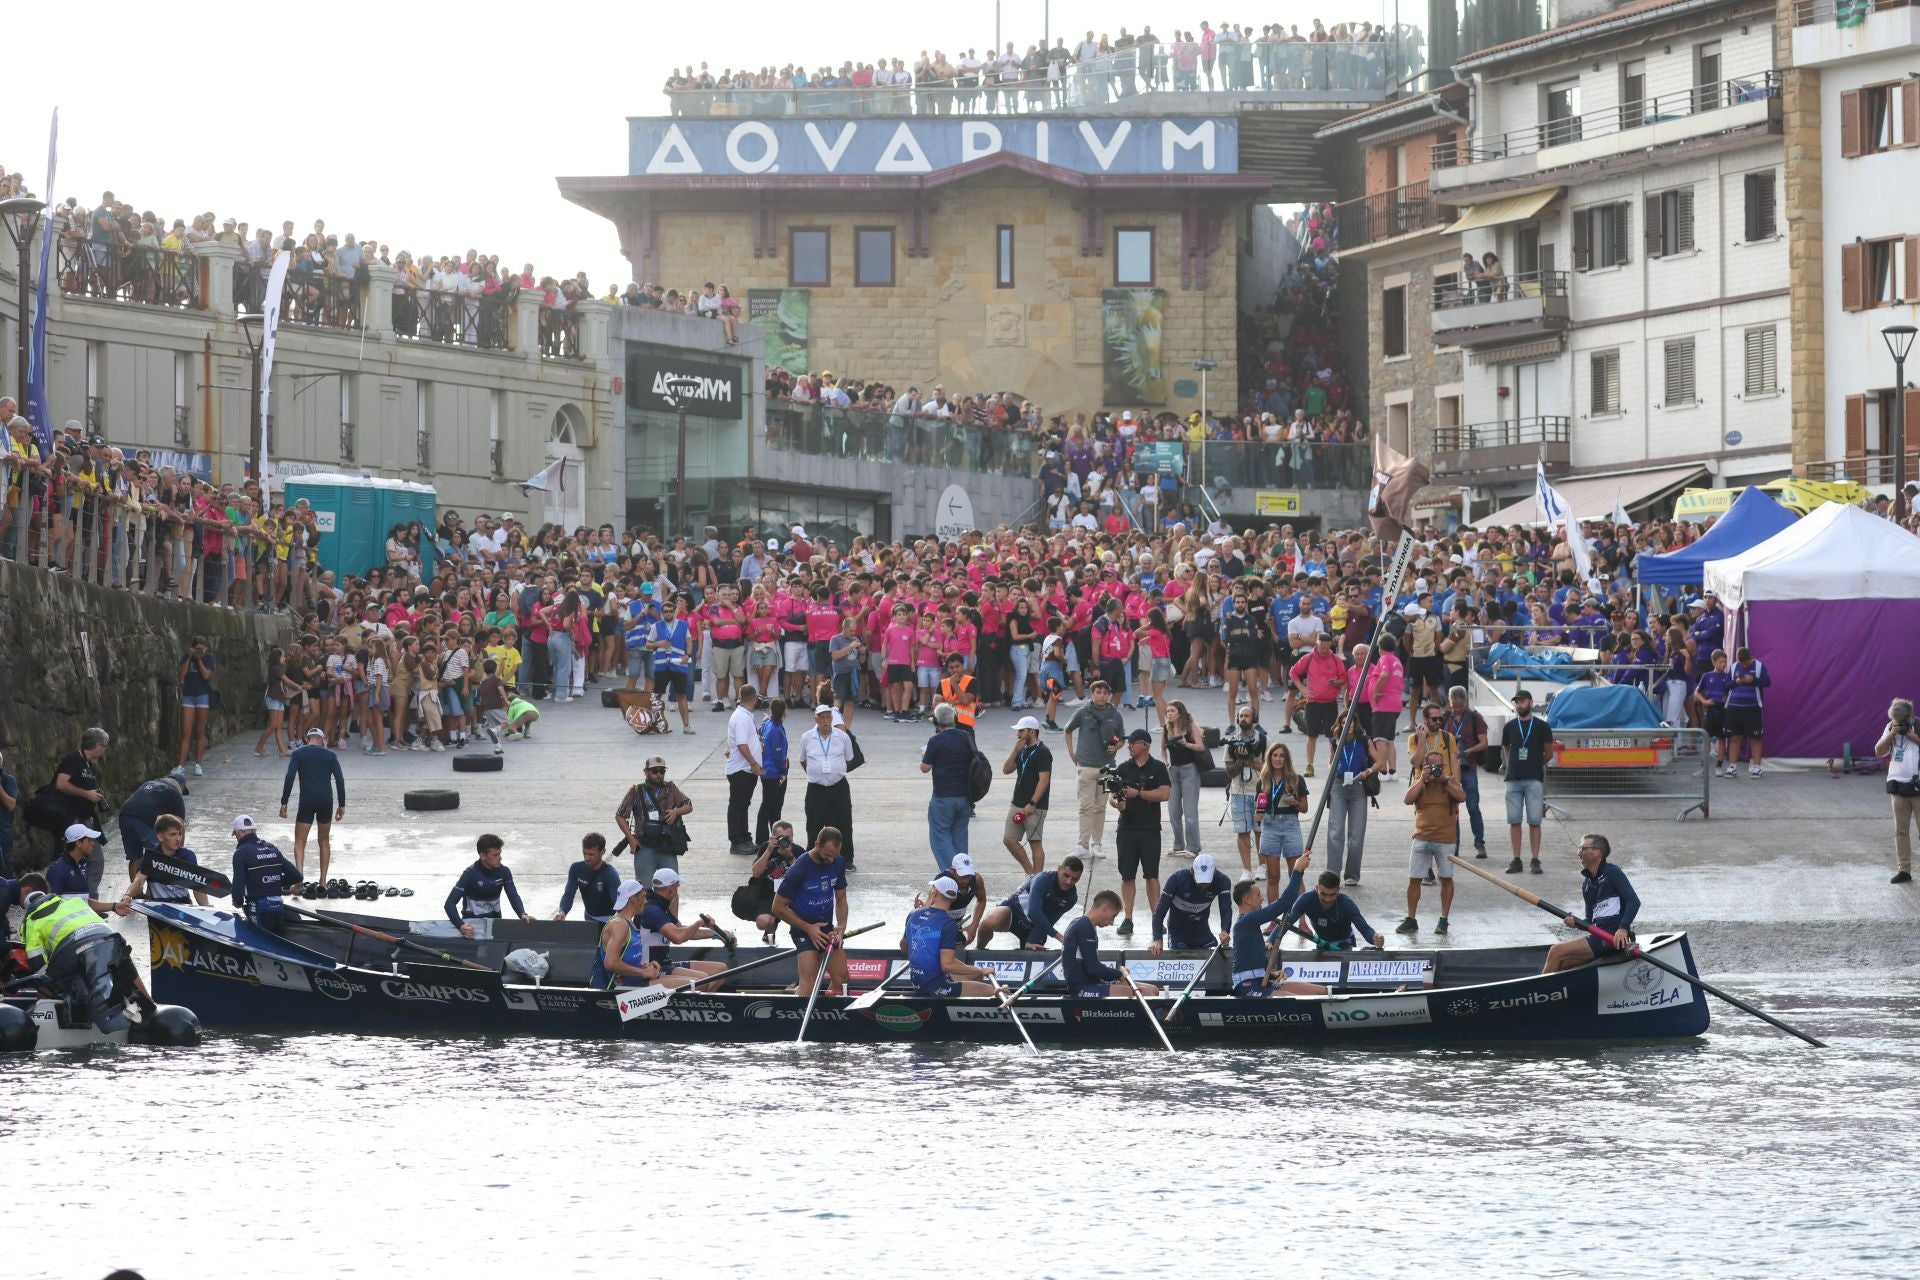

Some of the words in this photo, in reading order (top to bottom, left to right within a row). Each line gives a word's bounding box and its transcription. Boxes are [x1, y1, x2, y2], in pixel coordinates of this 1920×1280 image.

[1388, 537, 1412, 594] TRAMEINSA
[151, 860, 207, 886] TRAMEINSA
[277, 962, 289, 982] 3
[847, 962, 881, 972] ccident
[1158, 961, 1195, 971] Redes
[1299, 967, 1339, 979] barna
[380, 980, 490, 1003] CAMPOS
[628, 991, 668, 1009] TRAMEINSA
[1489, 986, 1569, 1010] zunibal
[775, 1008, 850, 1021] satink
[957, 1011, 1057, 1020] NAUTCAL
[1081, 1010, 1136, 1019] Bizkaialde
[1226, 1011, 1312, 1023] zamakoa
[1376, 1008, 1426, 1018] Marinoil
